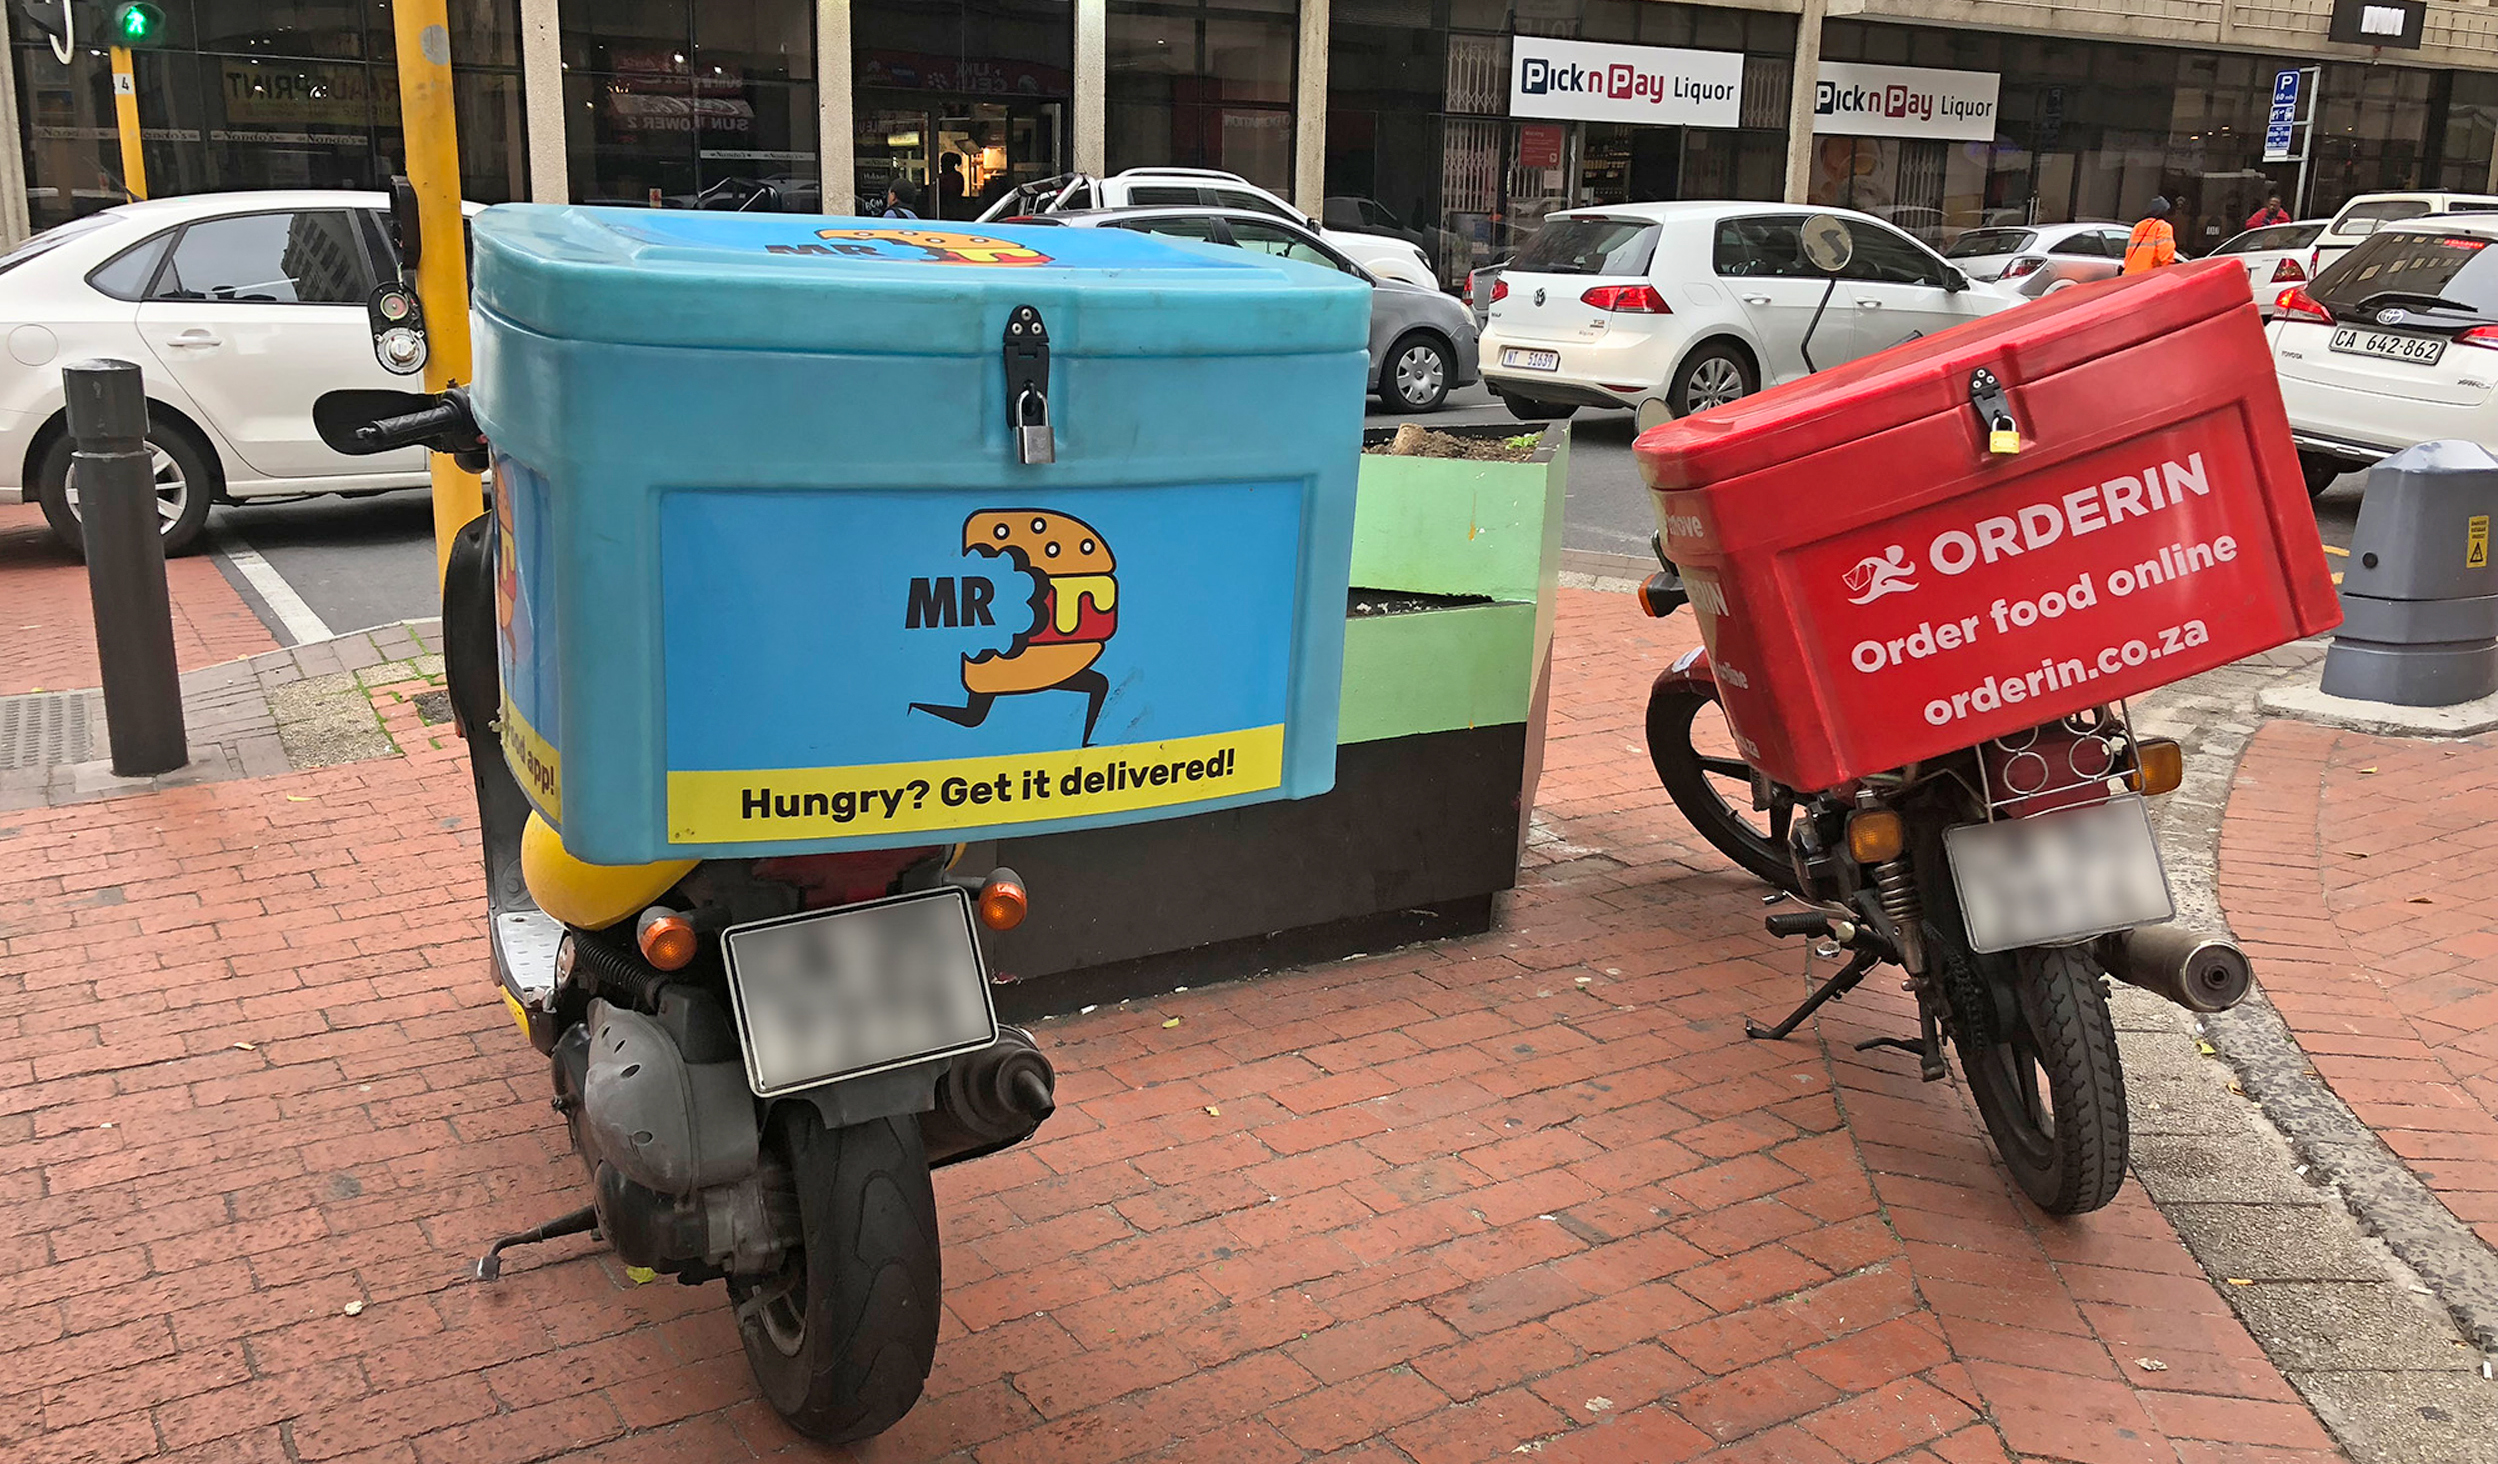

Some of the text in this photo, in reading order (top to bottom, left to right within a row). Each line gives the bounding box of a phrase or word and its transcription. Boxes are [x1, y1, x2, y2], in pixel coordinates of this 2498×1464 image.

[121, 76, 130, 91] 4
[1521, 58, 1734, 104] Pick n Pay Liquor
[1814, 81, 1993, 121] Pick n Pay Liquor
[2280, 75, 2293, 90] P
[764, 243, 884, 256] MR
[2335, 330, 2357, 348] CA
[1928, 451, 2211, 577] ORDERIN
[904, 575, 996, 630] MR
[1850, 532, 2239, 675] Order food online
[1923, 618, 2211, 727] orderin.co.za
[527, 750, 555, 796] app!
[741, 747, 1236, 824] Hungry? Get it delivered!
